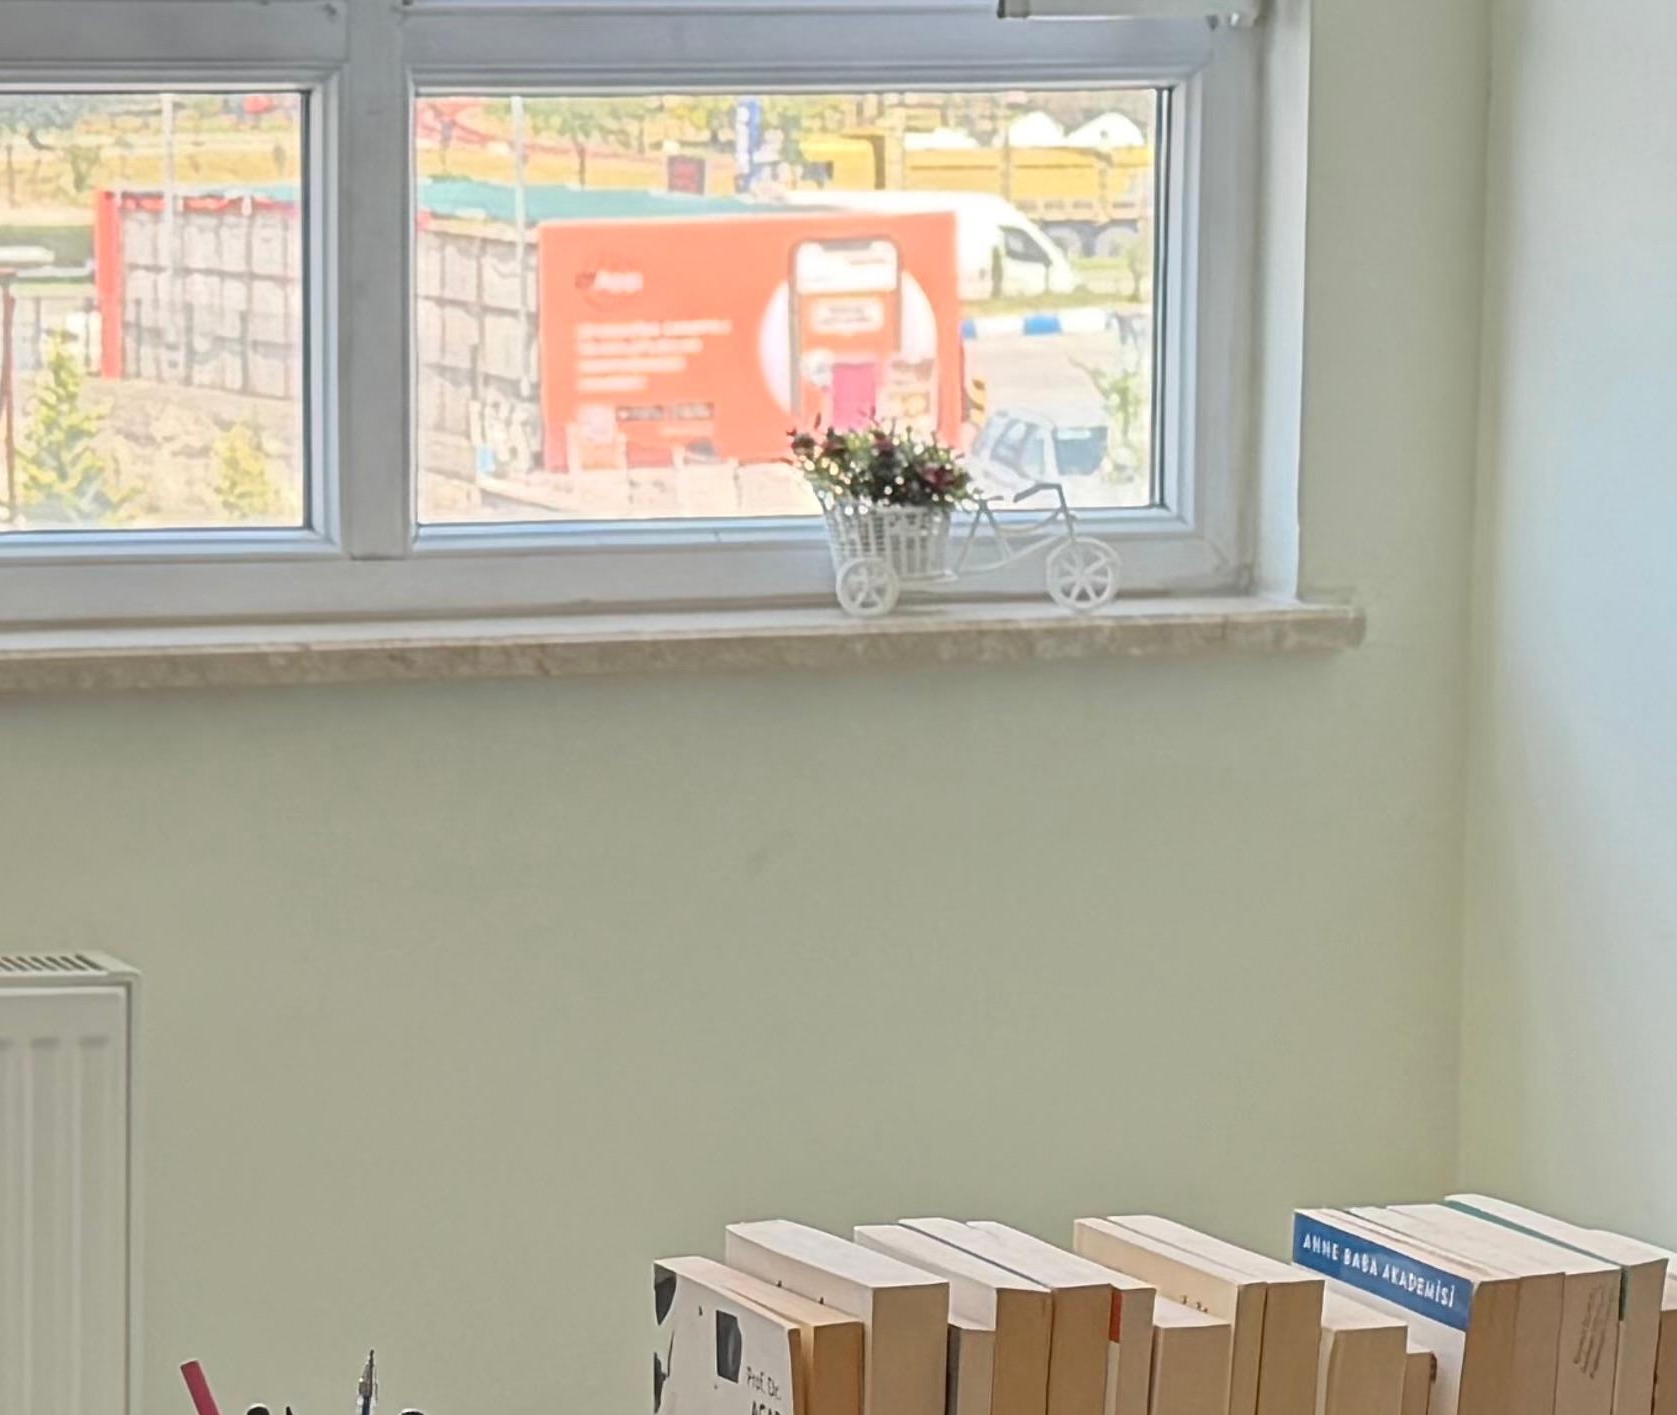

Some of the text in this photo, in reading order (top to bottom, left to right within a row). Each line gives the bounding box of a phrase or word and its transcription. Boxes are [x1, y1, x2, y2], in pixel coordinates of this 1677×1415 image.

[1302, 1233, 1457, 1309] ANNE BABA AKADEMİSİ
